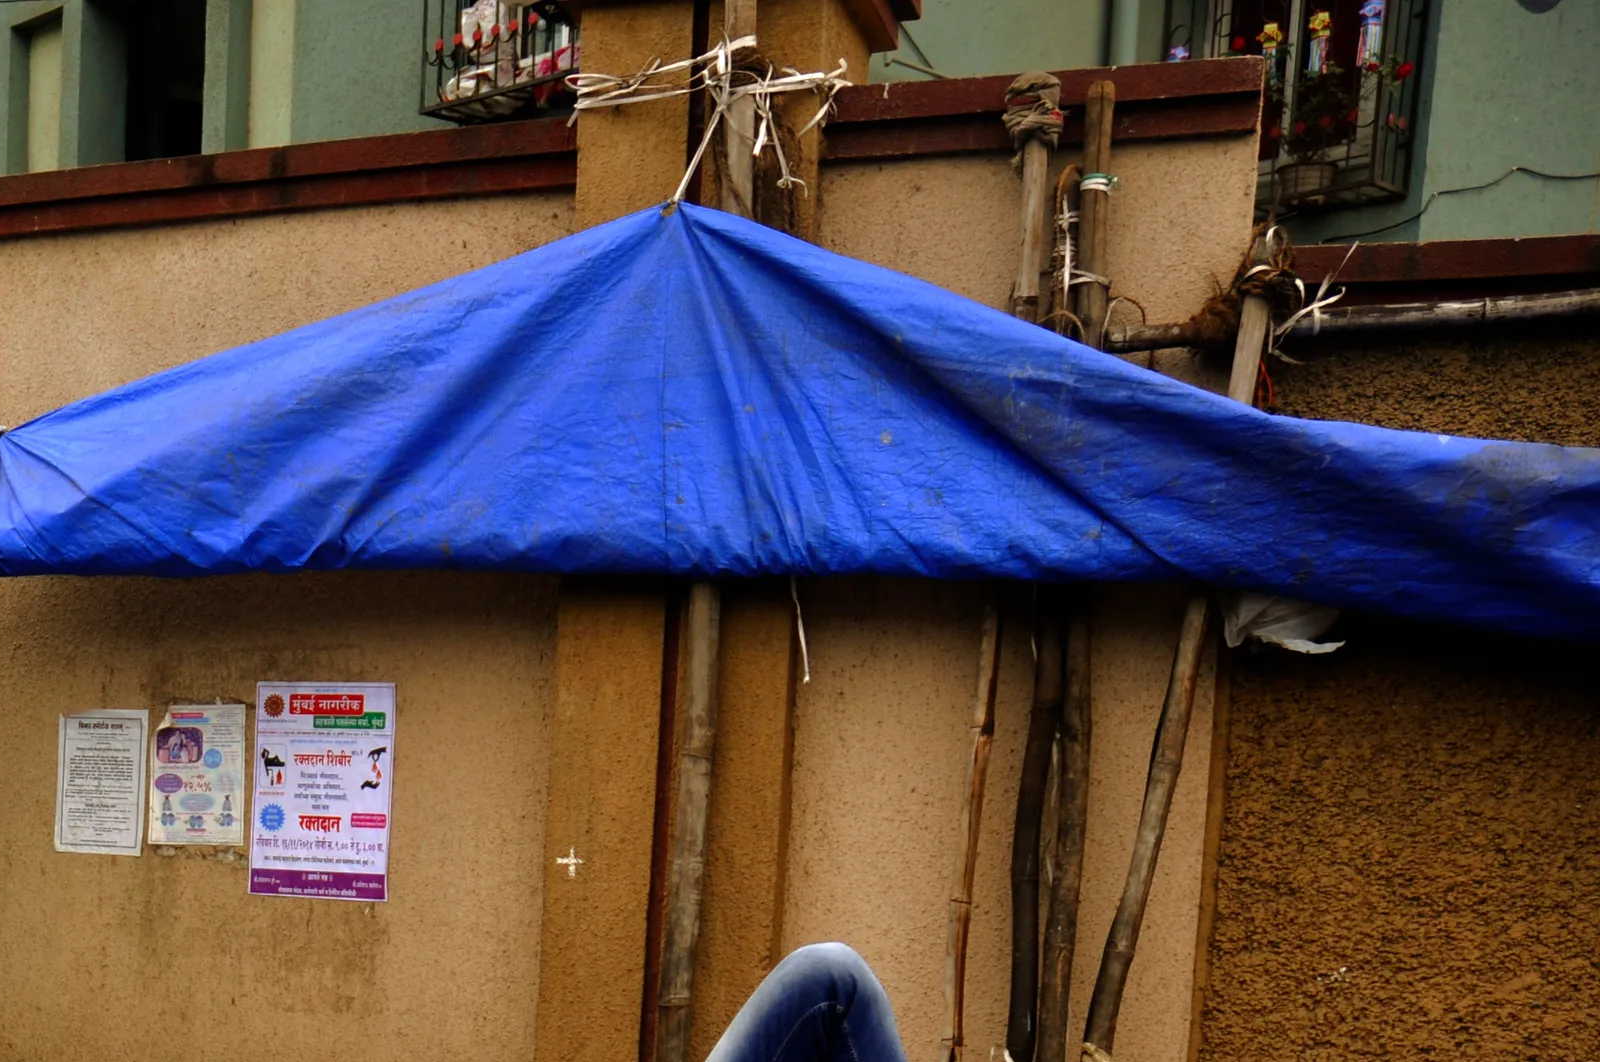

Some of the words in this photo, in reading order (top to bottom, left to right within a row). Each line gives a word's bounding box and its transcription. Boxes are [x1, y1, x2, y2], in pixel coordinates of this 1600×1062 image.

[292, 695, 314, 714] मुंबई
[319, 695, 361, 711] नागरीक
[371, 717, 384, 729] मुंबई
[293, 753, 324, 767] रक्तदान
[326, 750, 352, 767] शिबीर
[298, 814, 342, 833] रक्तदान
